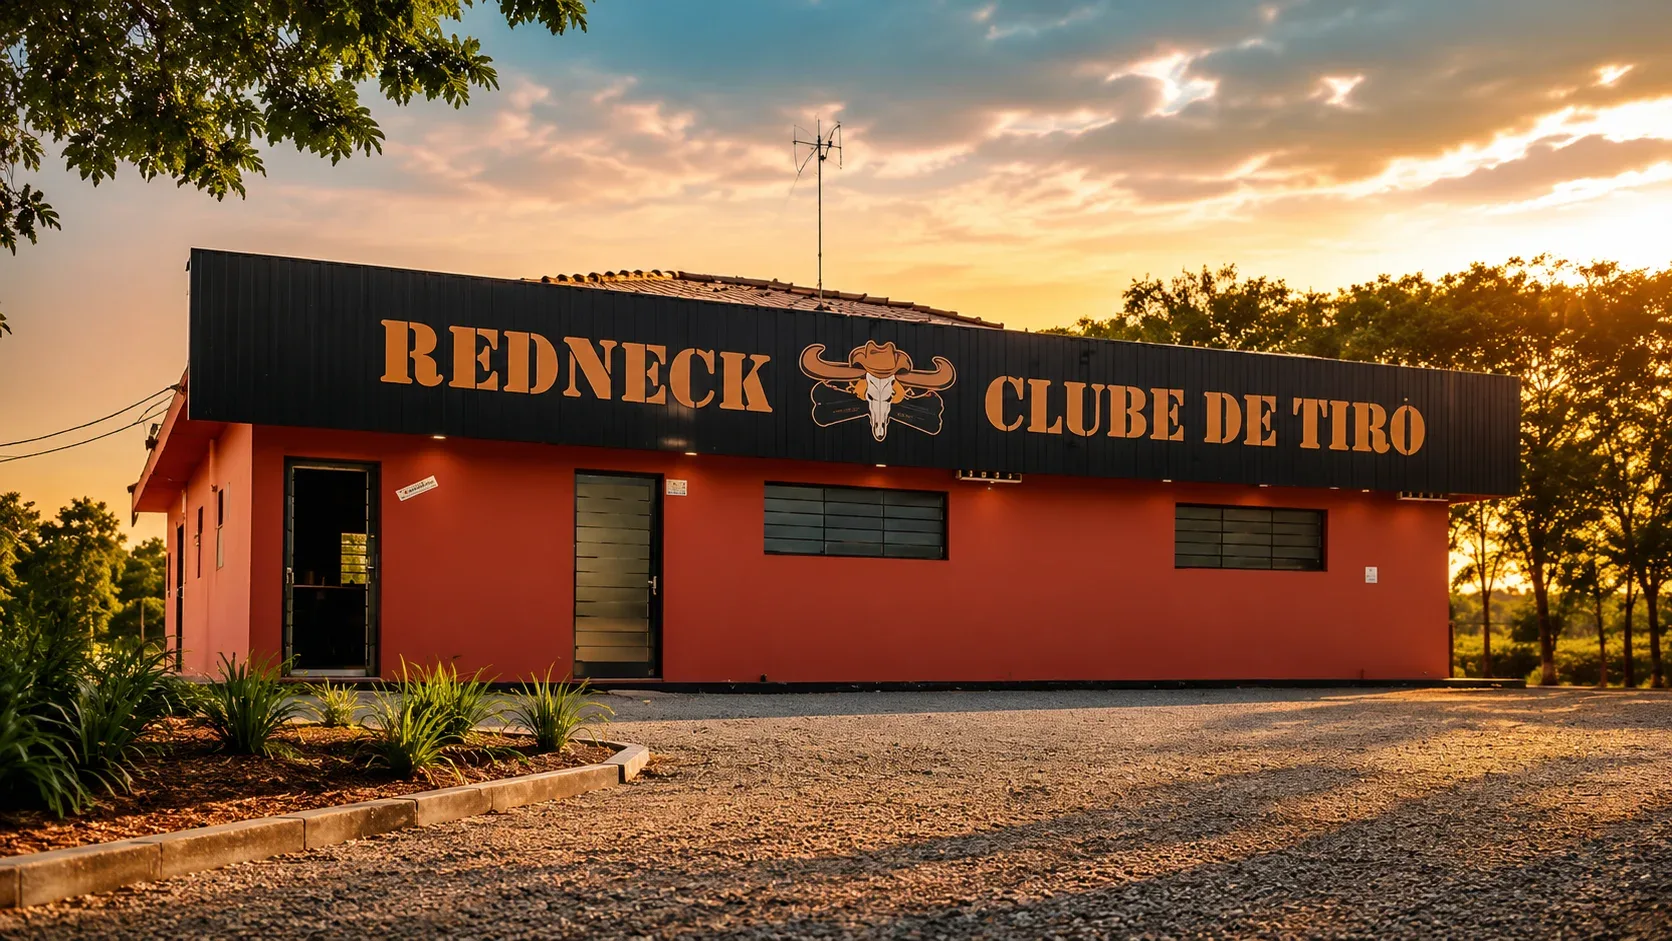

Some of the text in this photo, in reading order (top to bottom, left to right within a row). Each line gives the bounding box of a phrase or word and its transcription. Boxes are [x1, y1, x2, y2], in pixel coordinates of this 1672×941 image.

[381, 320, 1425, 455] REDNECK CLUBE DE TIRO
